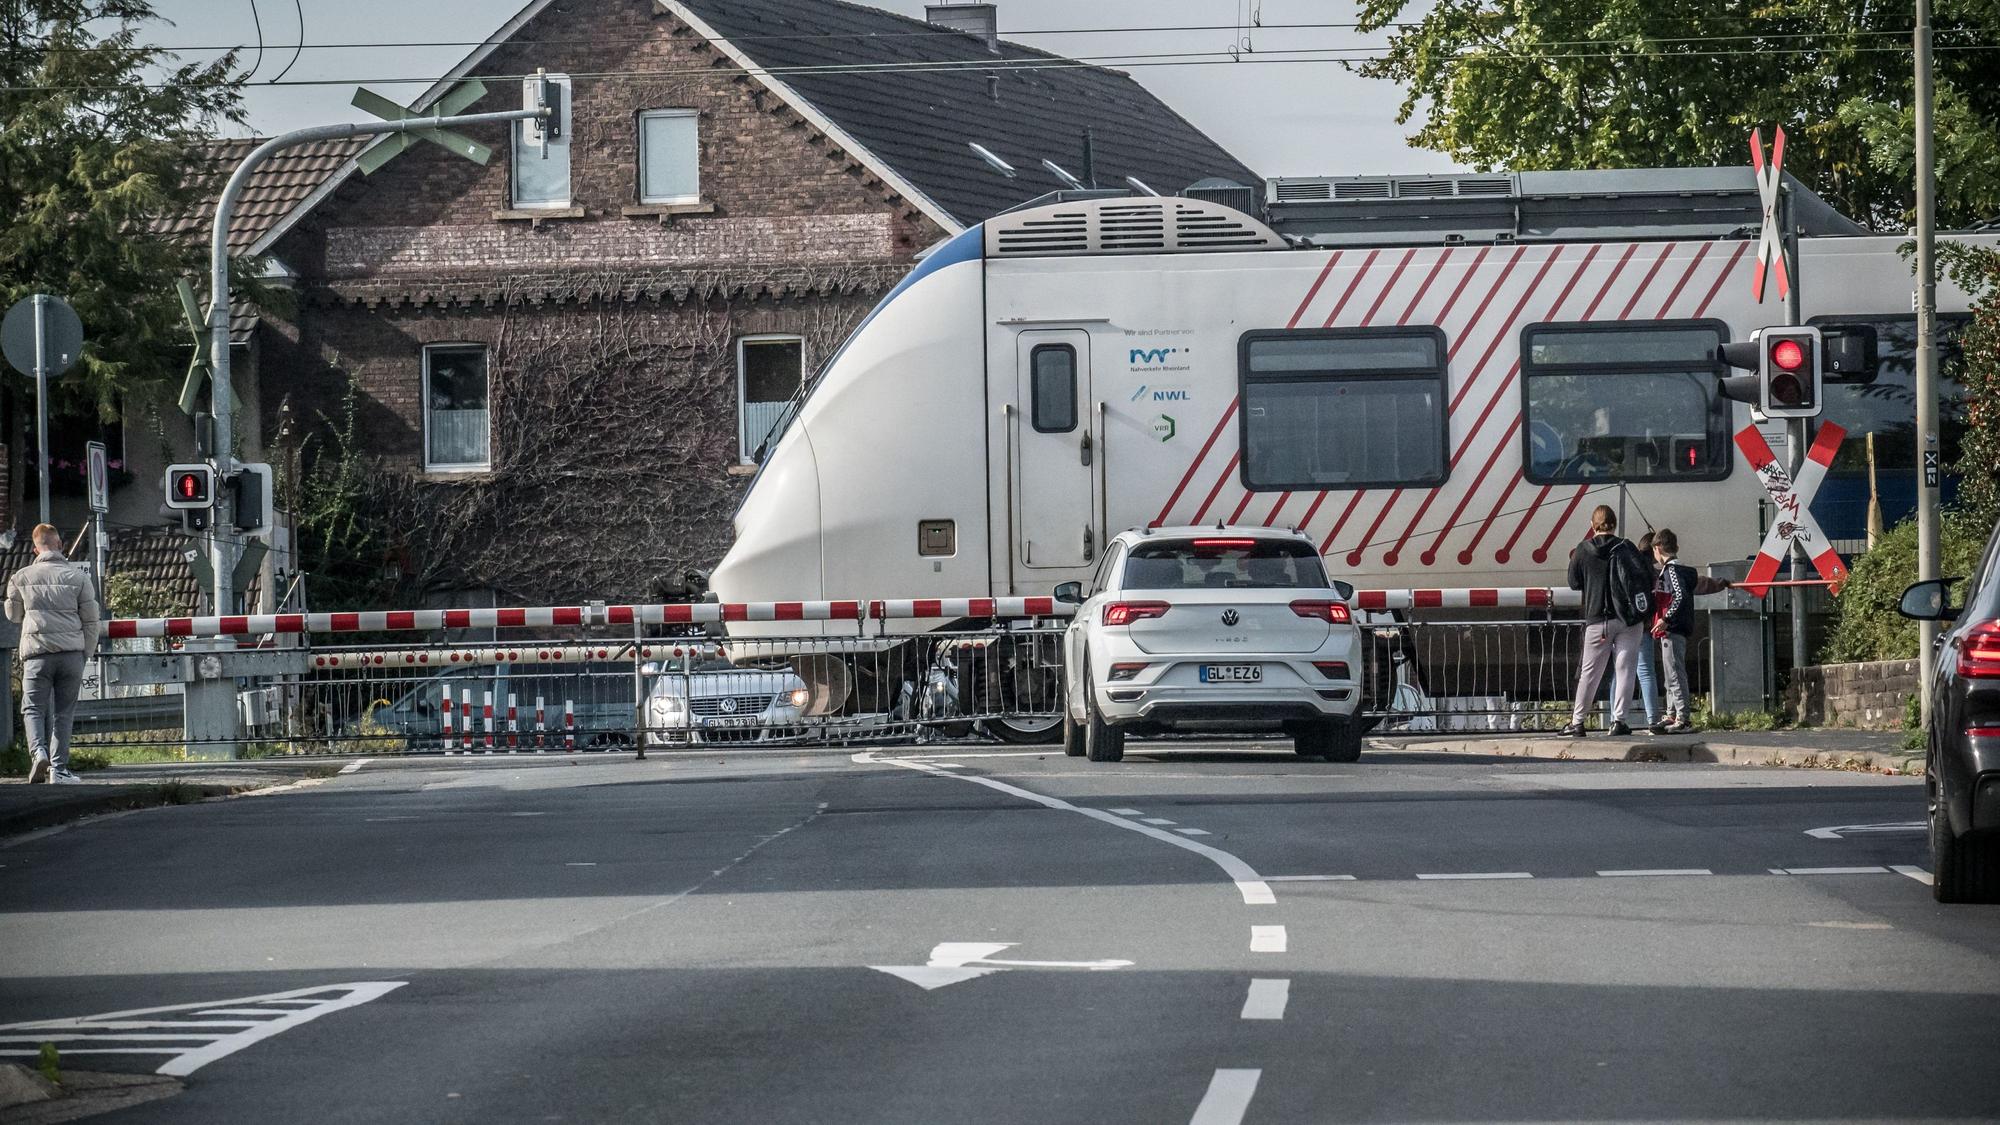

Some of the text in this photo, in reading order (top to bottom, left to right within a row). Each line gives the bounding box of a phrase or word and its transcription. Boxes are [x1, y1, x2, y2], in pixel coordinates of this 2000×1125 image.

[1833, 361, 1839, 370] 9
[1153, 390, 1191, 401] NWL
[196, 518, 201, 526] 5
[255, 518, 259, 526] 1
[1207, 667, 1260, 680] GL EZ6
